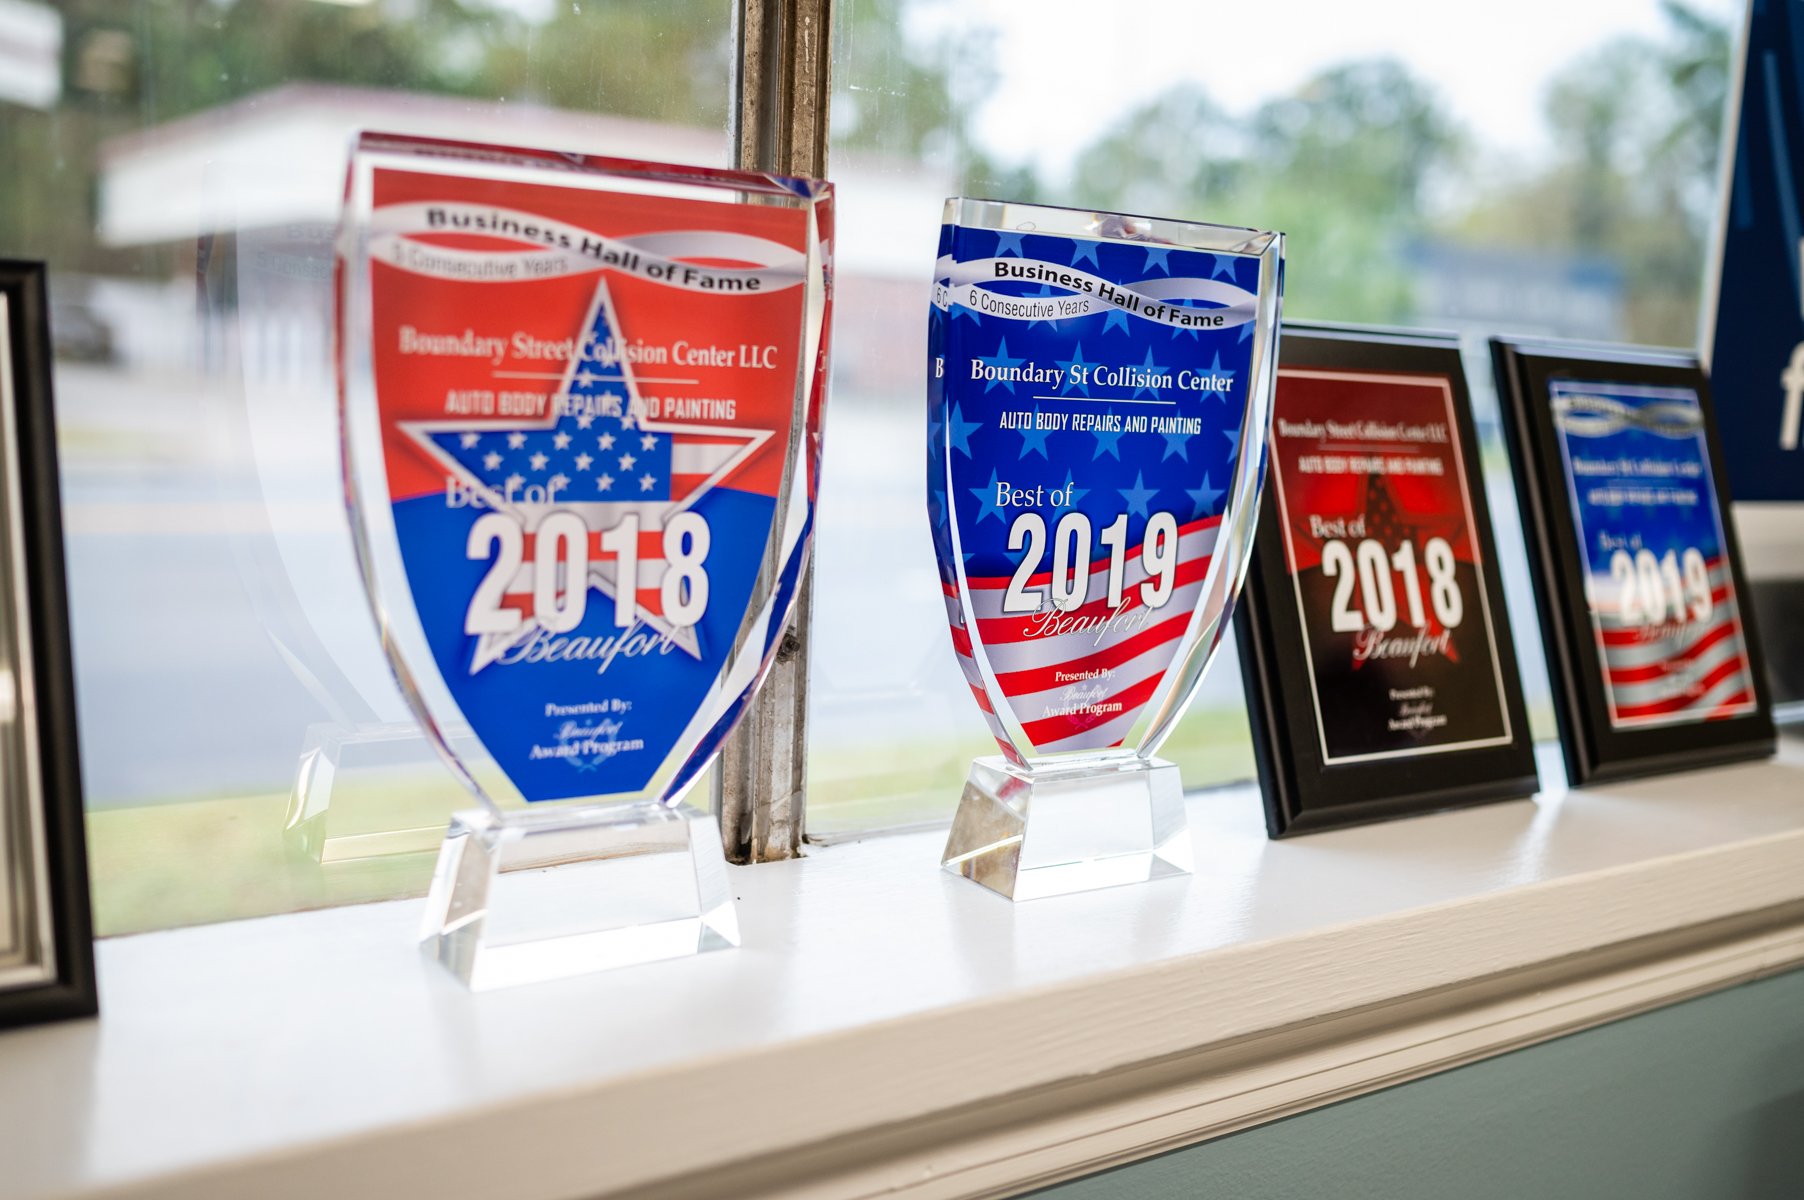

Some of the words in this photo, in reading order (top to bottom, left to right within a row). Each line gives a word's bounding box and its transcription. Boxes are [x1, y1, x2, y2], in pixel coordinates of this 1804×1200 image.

[408, 248, 518, 277] Consecutive
[522, 256, 569, 276] Years
[427, 207, 571, 248] Business
[581, 237, 640, 271] Hall
[647, 263, 675, 281] of
[683, 269, 762, 290] Fame
[969, 290, 978, 306] 6
[981, 293, 1054, 318] Consecutive
[1058, 300, 1089, 316] Years
[994, 262, 1093, 292] Business
[1098, 283, 1139, 311] Hall
[1143, 305, 1165, 319] of
[1169, 309, 1224, 327] Fame
[398, 325, 509, 366] Boundary
[511, 331, 575, 361] Street
[579, 336, 668, 363] Collision
[672, 340, 735, 367] Center
[739, 344, 778, 369] LLC
[970, 359, 1065, 390] Boundary
[1069, 364, 1088, 385] St
[1093, 366, 1172, 389] Collision
[1177, 370, 1234, 392] Center
[444, 389, 496, 415] AUTO
[497, 391, 548, 416] BODY
[550, 392, 623, 417] REPAIRS
[627, 396, 660, 419] AND
[664, 398, 736, 420] PAINTING
[1000, 411, 1032, 429] AUTO
[1036, 412, 1069, 431] BODY
[1072, 414, 1121, 432] REPAIRS
[1124, 416, 1148, 433] AND
[1151, 416, 1201, 434] PAINTING
[446, 477, 517, 508] Best
[524, 474, 560, 505] of
[995, 481, 1044, 507] Best
[1050, 482, 1075, 507] of
[1309, 514, 1346, 538] Best
[1348, 513, 1367, 538] of
[465, 510, 711, 635] 2018
[1003, 511, 1178, 613] 2019
[1322, 537, 1463, 633] 2018
[1609, 547, 1713, 625] 2019
[1023, 597, 1154, 647] Beaufort
[496, 614, 681, 675] Beaufort
[1353, 620, 1451, 668] Beaufort
[1055, 668, 1099, 681] Presented
[1101, 668, 1116, 681] By:
[545, 699, 609, 717] Presented
[610, 698, 633, 715] By:
[1042, 703, 1077, 718] Award
[1079, 702, 1123, 716] Program
[529, 740, 580, 760] Award
[581, 739, 645, 757] Program
